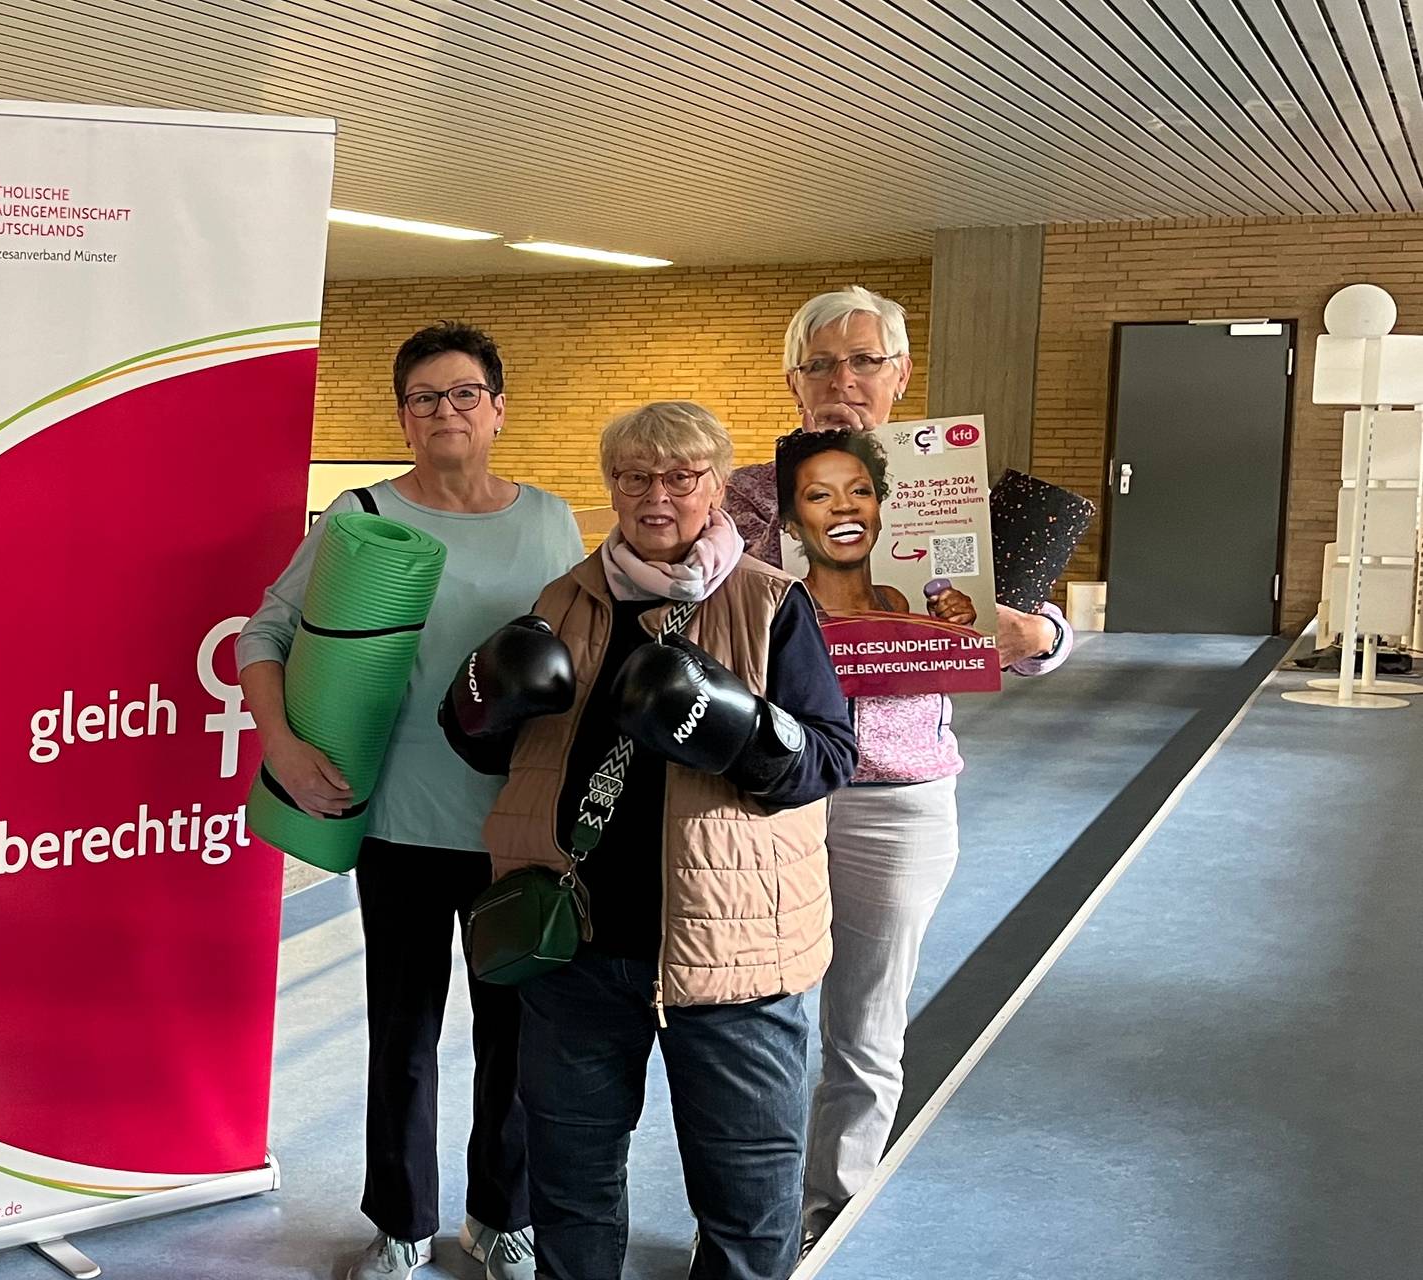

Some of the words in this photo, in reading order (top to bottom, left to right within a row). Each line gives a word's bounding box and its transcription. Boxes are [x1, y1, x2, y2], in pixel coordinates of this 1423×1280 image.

[74, 250, 117, 263] Münster
[952, 429, 973, 441] kfd
[952, 476, 975, 485] 2024
[897, 490, 924, 499] 09:30
[934, 488, 958, 497] 17:30
[960, 486, 978, 494] Uhr
[891, 496, 984, 510] St.-Pius-Gymnasium
[918, 507, 957, 517] Coesfeld
[829, 638, 957, 656] EN.GESUNDHEIT-
[960, 636, 996, 650] LIVE!
[835, 659, 985, 675] GIE.BEWEGUNG.IMPULSE
[468, 652, 483, 703] KWON
[29, 683, 177, 763] gleich
[673, 689, 711, 744] KWON
